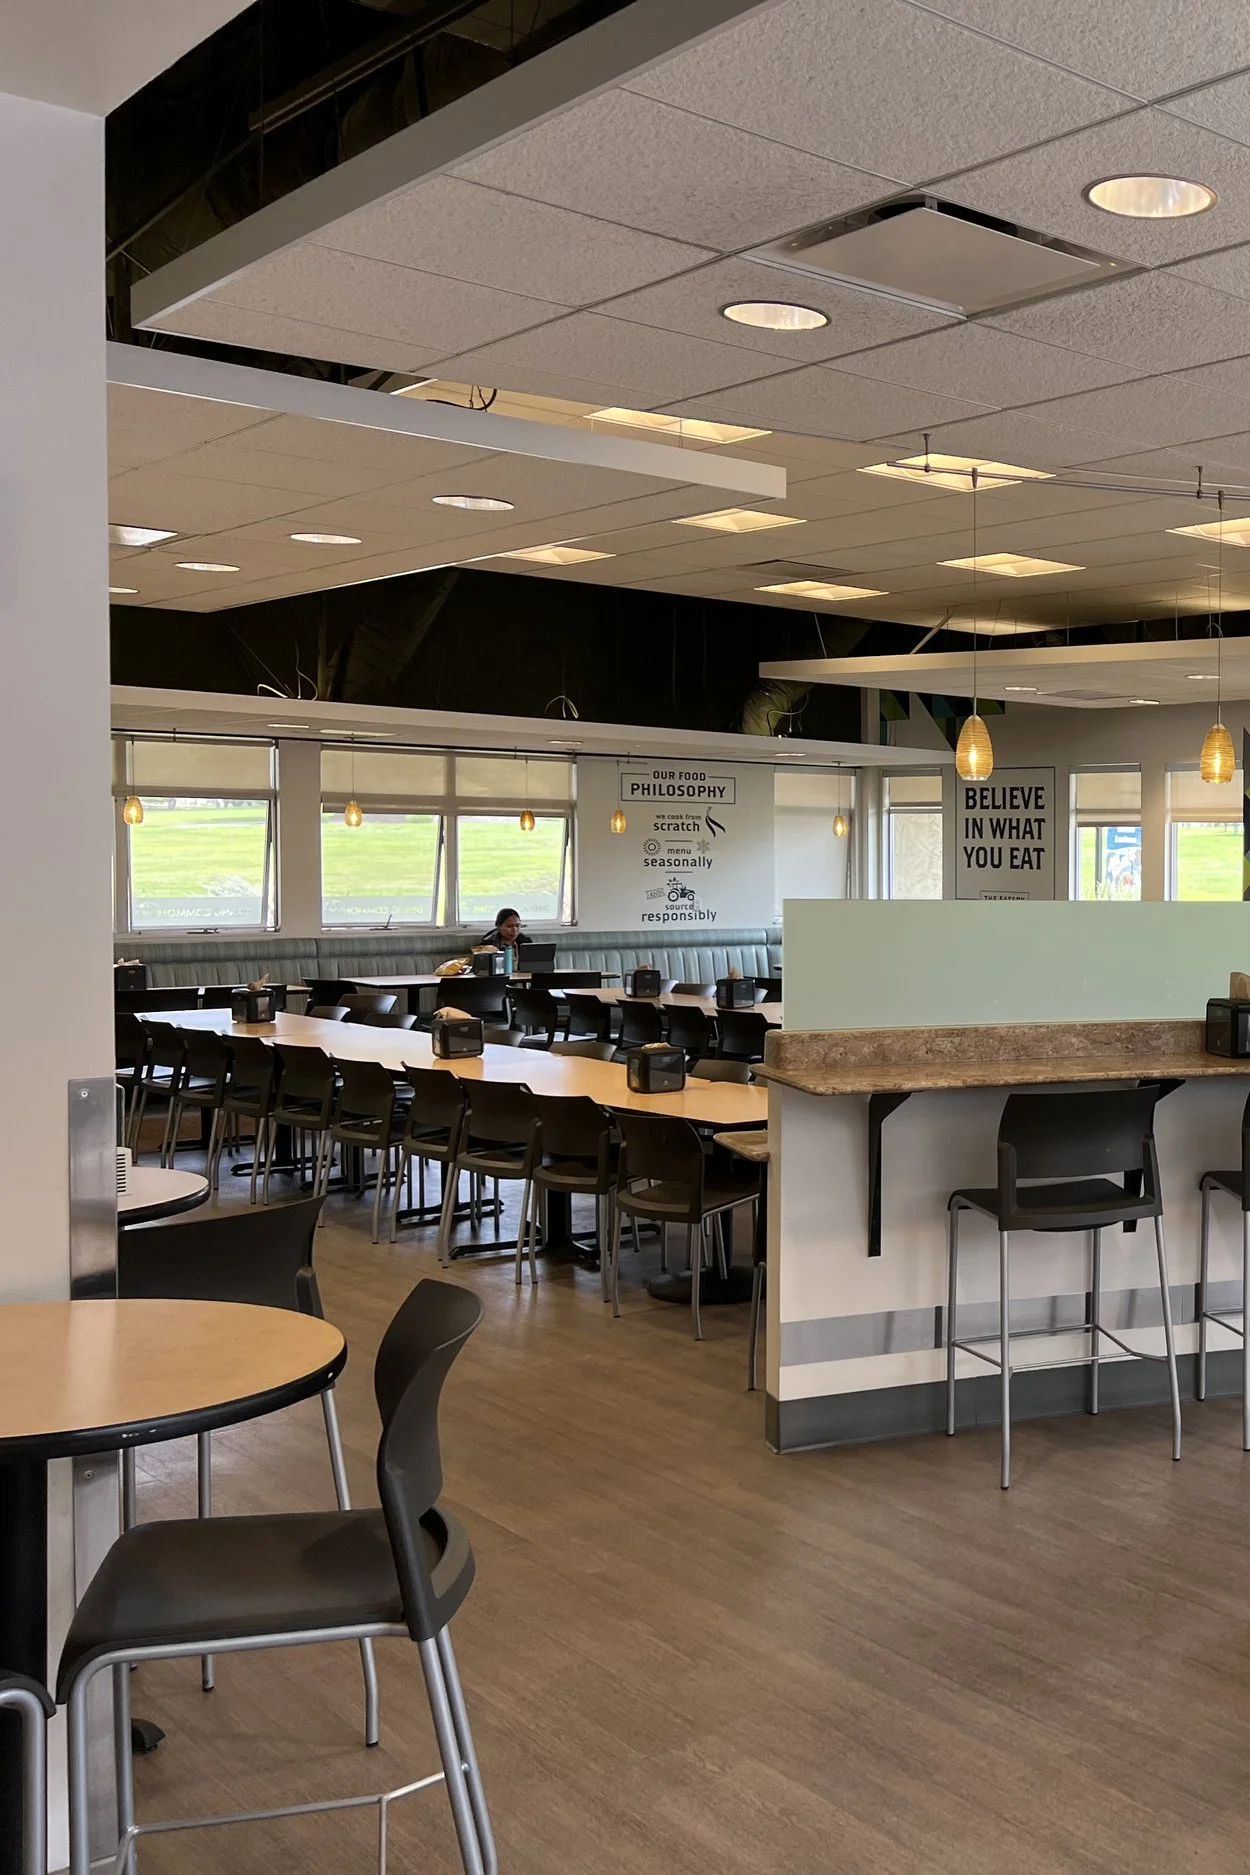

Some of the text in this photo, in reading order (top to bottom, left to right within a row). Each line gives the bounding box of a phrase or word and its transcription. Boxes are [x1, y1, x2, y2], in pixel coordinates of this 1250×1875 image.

[653, 770, 706, 781] OUR FOOD
[631, 783, 726, 799] PHILOSOPHY
[964, 786, 1046, 810] BELIEVE
[685, 813, 702, 821] from
[653, 820, 700, 832] scratch
[964, 817, 1046, 841] IN WHAT
[643, 856, 713, 869] seasonally
[963, 846, 1046, 870] YOU EAT
[641, 909, 717, 923] responsibly
